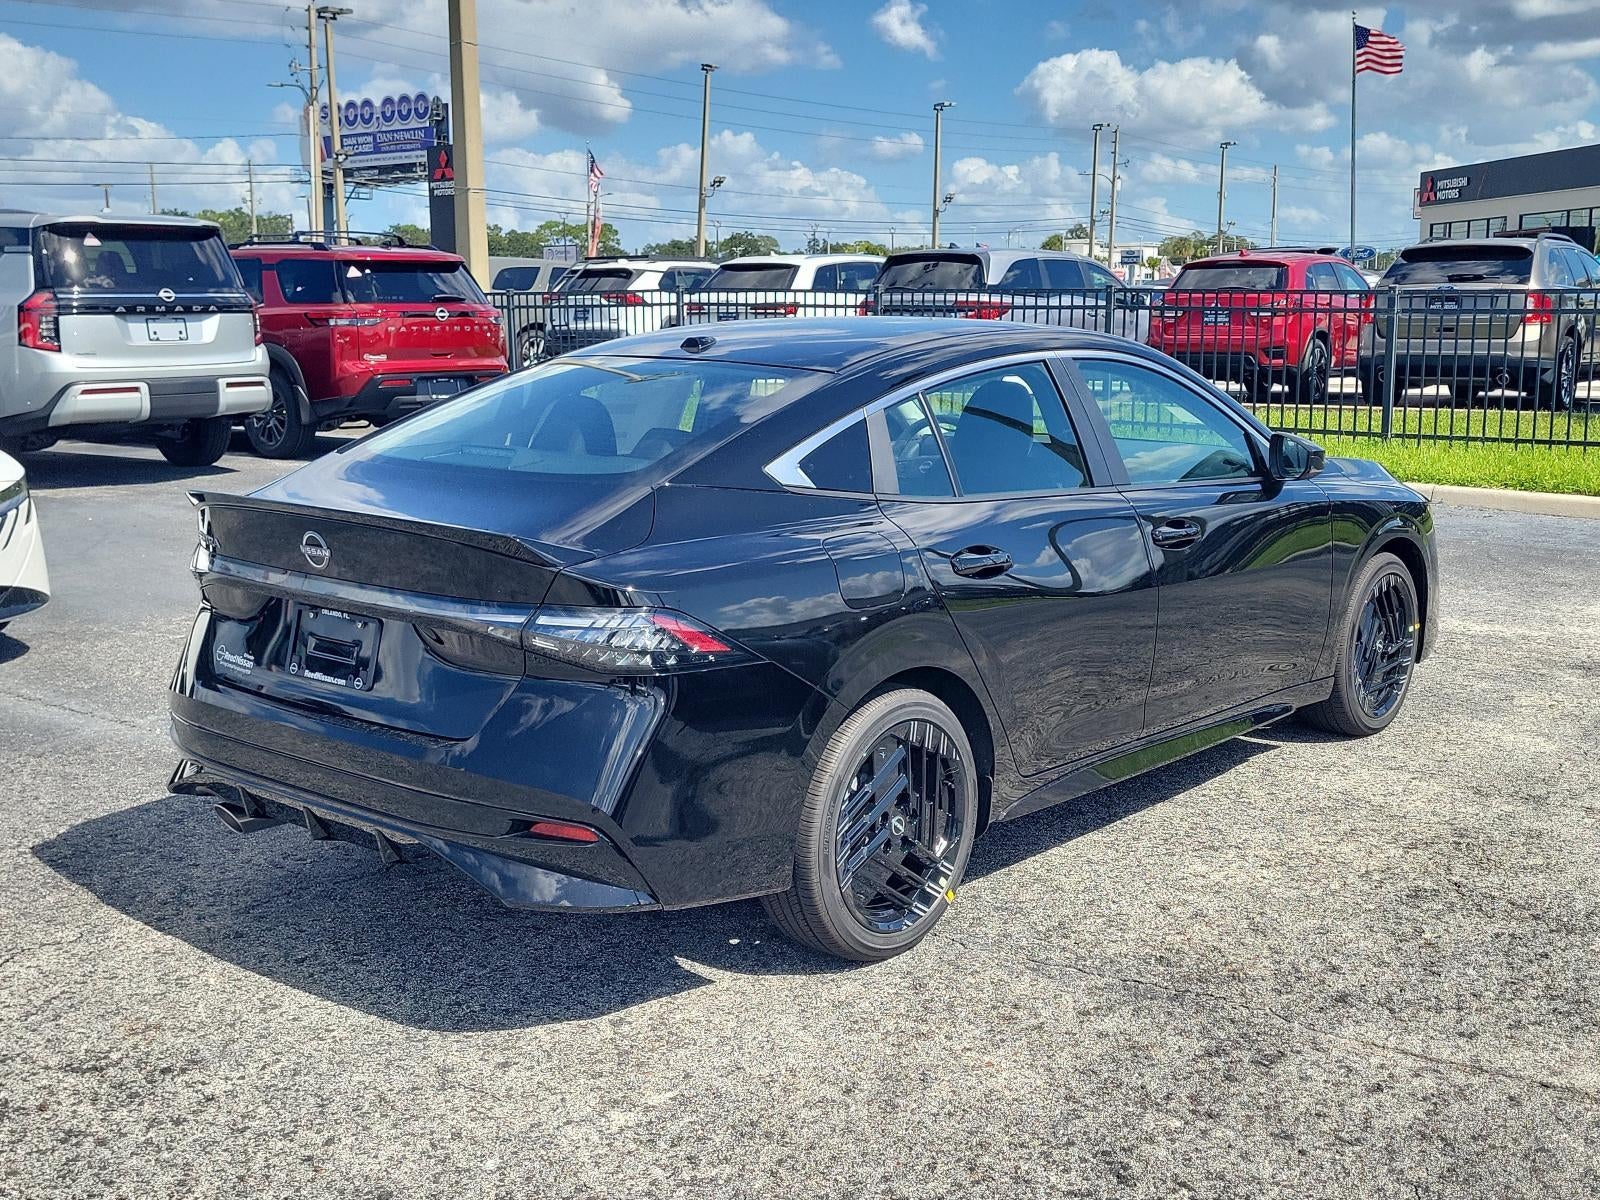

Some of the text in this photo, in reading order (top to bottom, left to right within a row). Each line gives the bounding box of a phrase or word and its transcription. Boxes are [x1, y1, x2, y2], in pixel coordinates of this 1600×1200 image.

[320, 93, 431, 129] $00,000
[357, 134, 373, 144] WON
[377, 129, 425, 142] DAN NEWLIN
[1437, 177, 1468, 189] MITSUBISHI
[1437, 189, 1460, 200] MOTORS
[115, 305, 218, 313] ARMADA
[387, 325, 489, 333] PATHFINDER
[304, 669, 346, 686] ReedNissan.com
